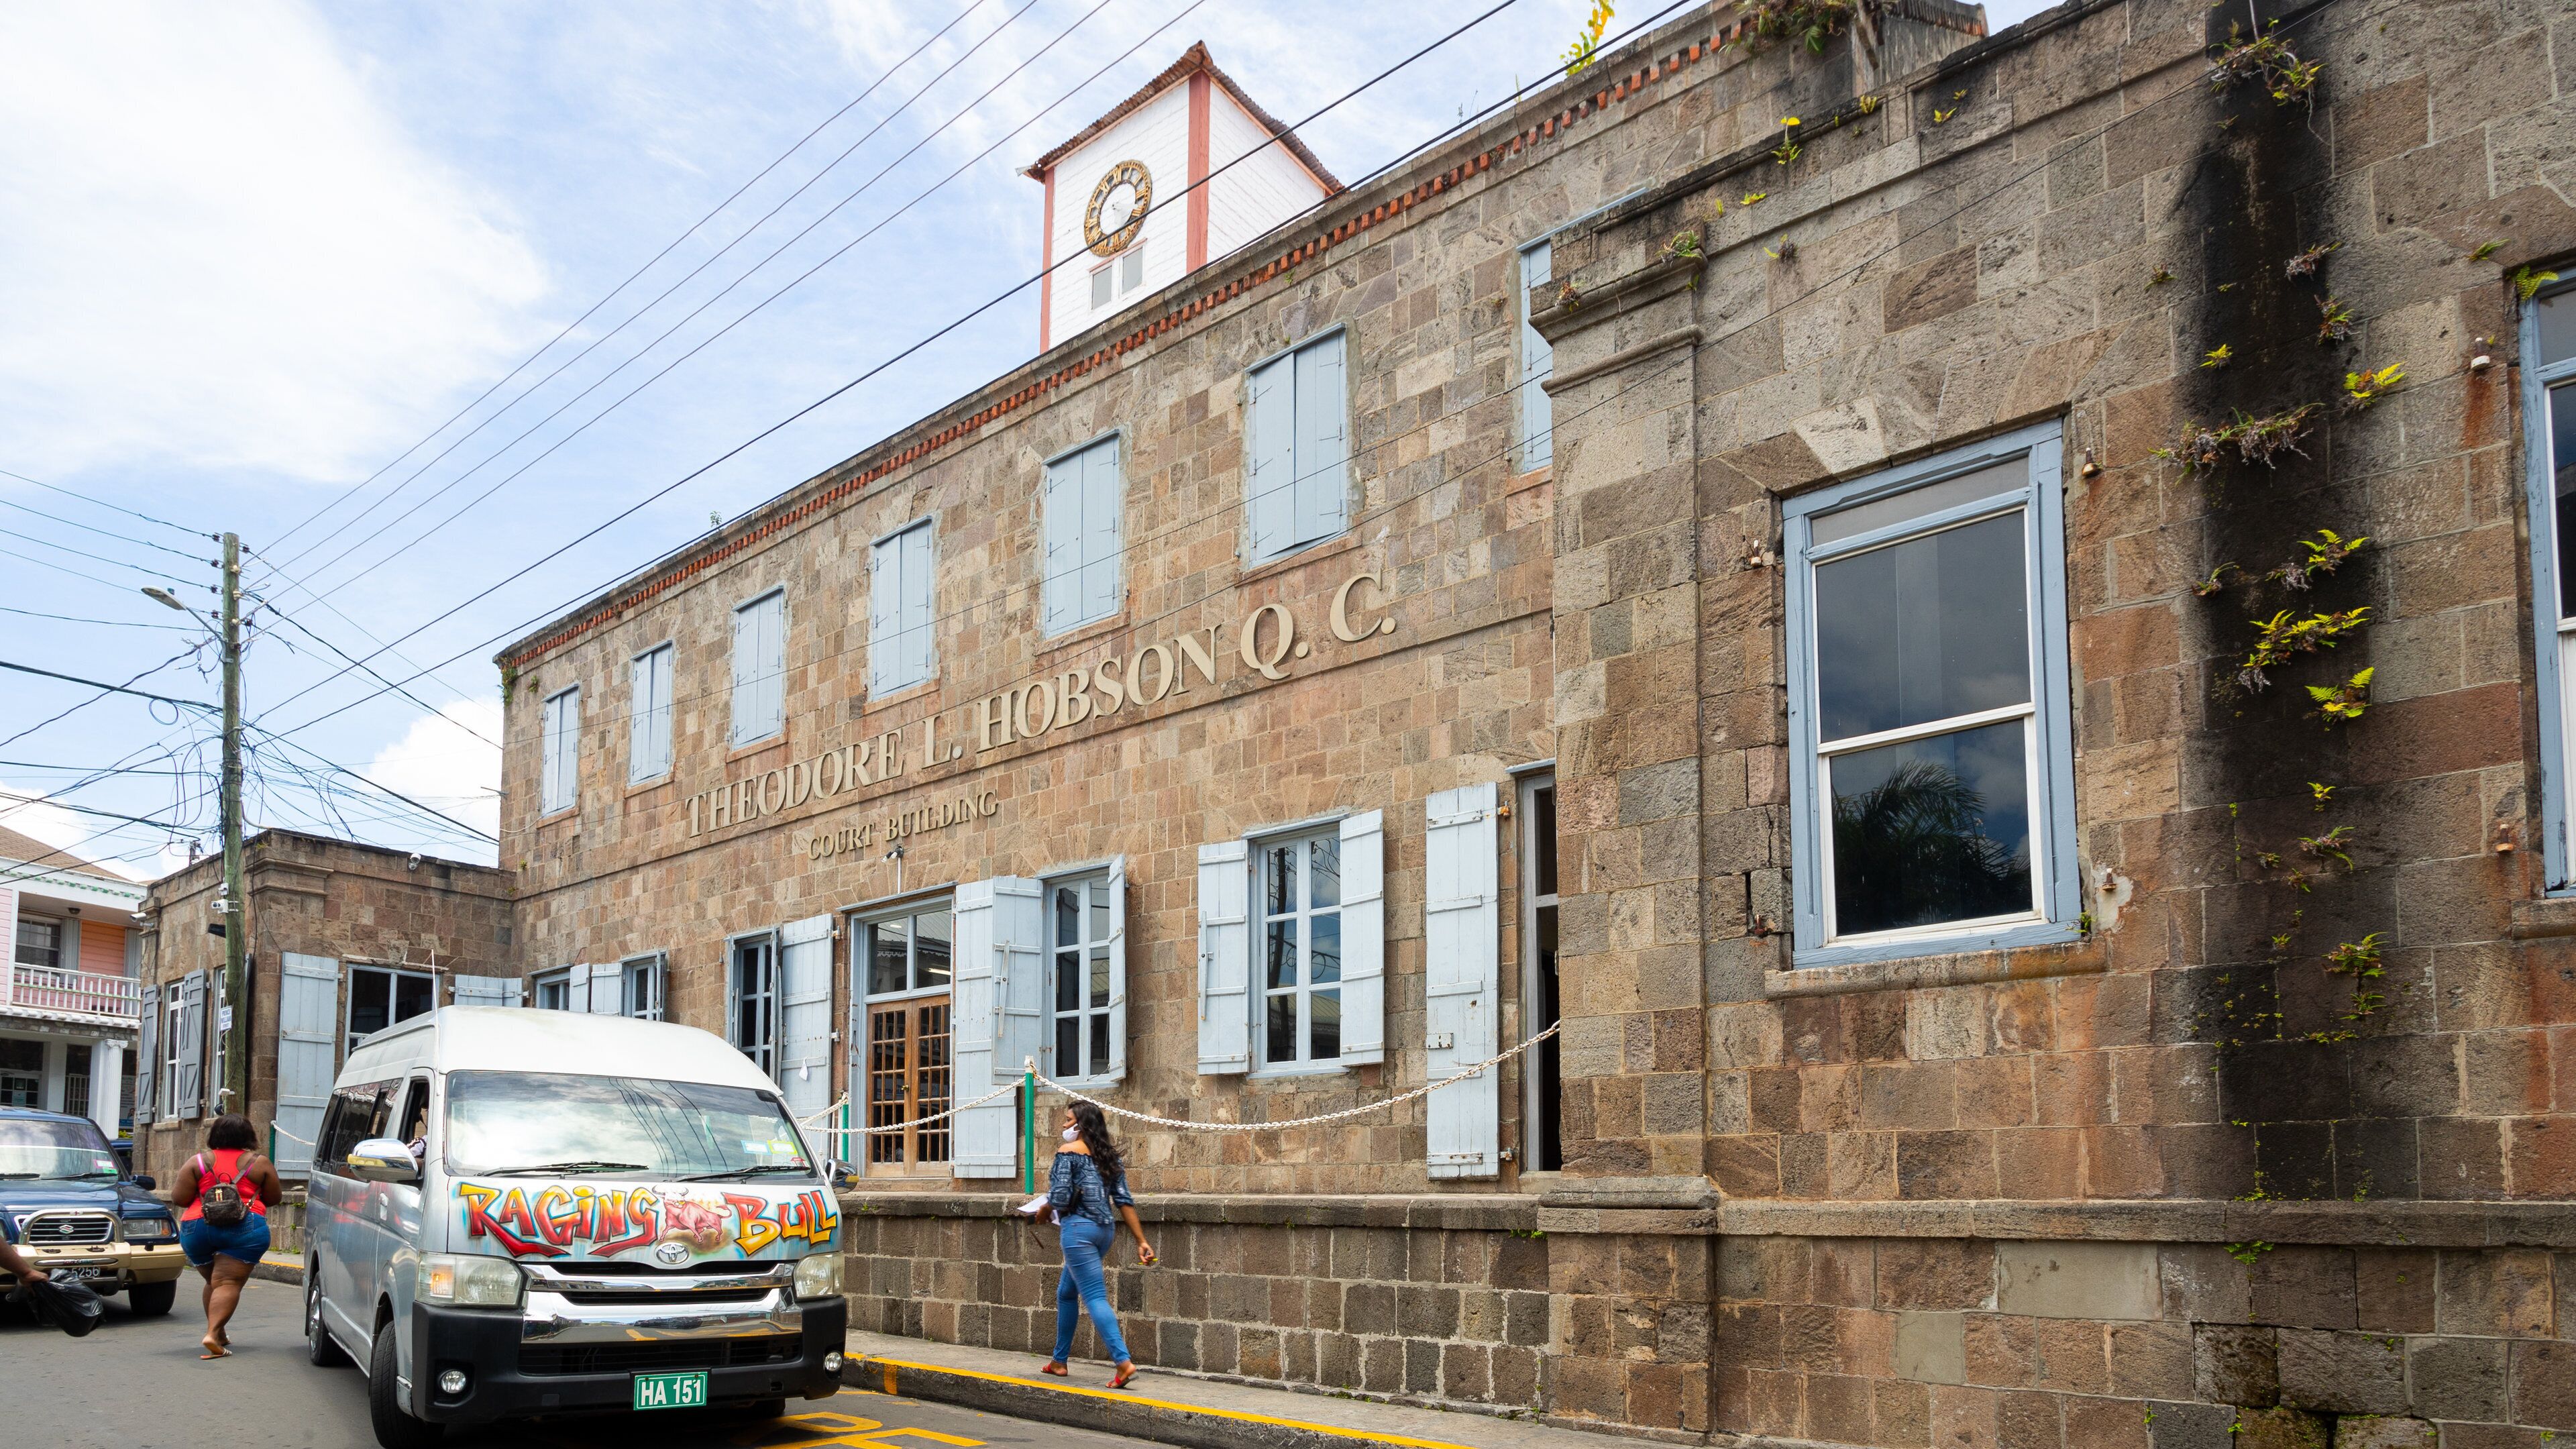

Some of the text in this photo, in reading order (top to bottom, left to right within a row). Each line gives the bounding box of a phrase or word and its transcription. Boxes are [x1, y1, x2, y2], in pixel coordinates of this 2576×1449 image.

[685, 572, 1397, 839] THEODORE L. HOBSON Q. C.
[808, 789, 998, 860] COURT BUILDING
[641, 1376, 701, 1406] HA 151
